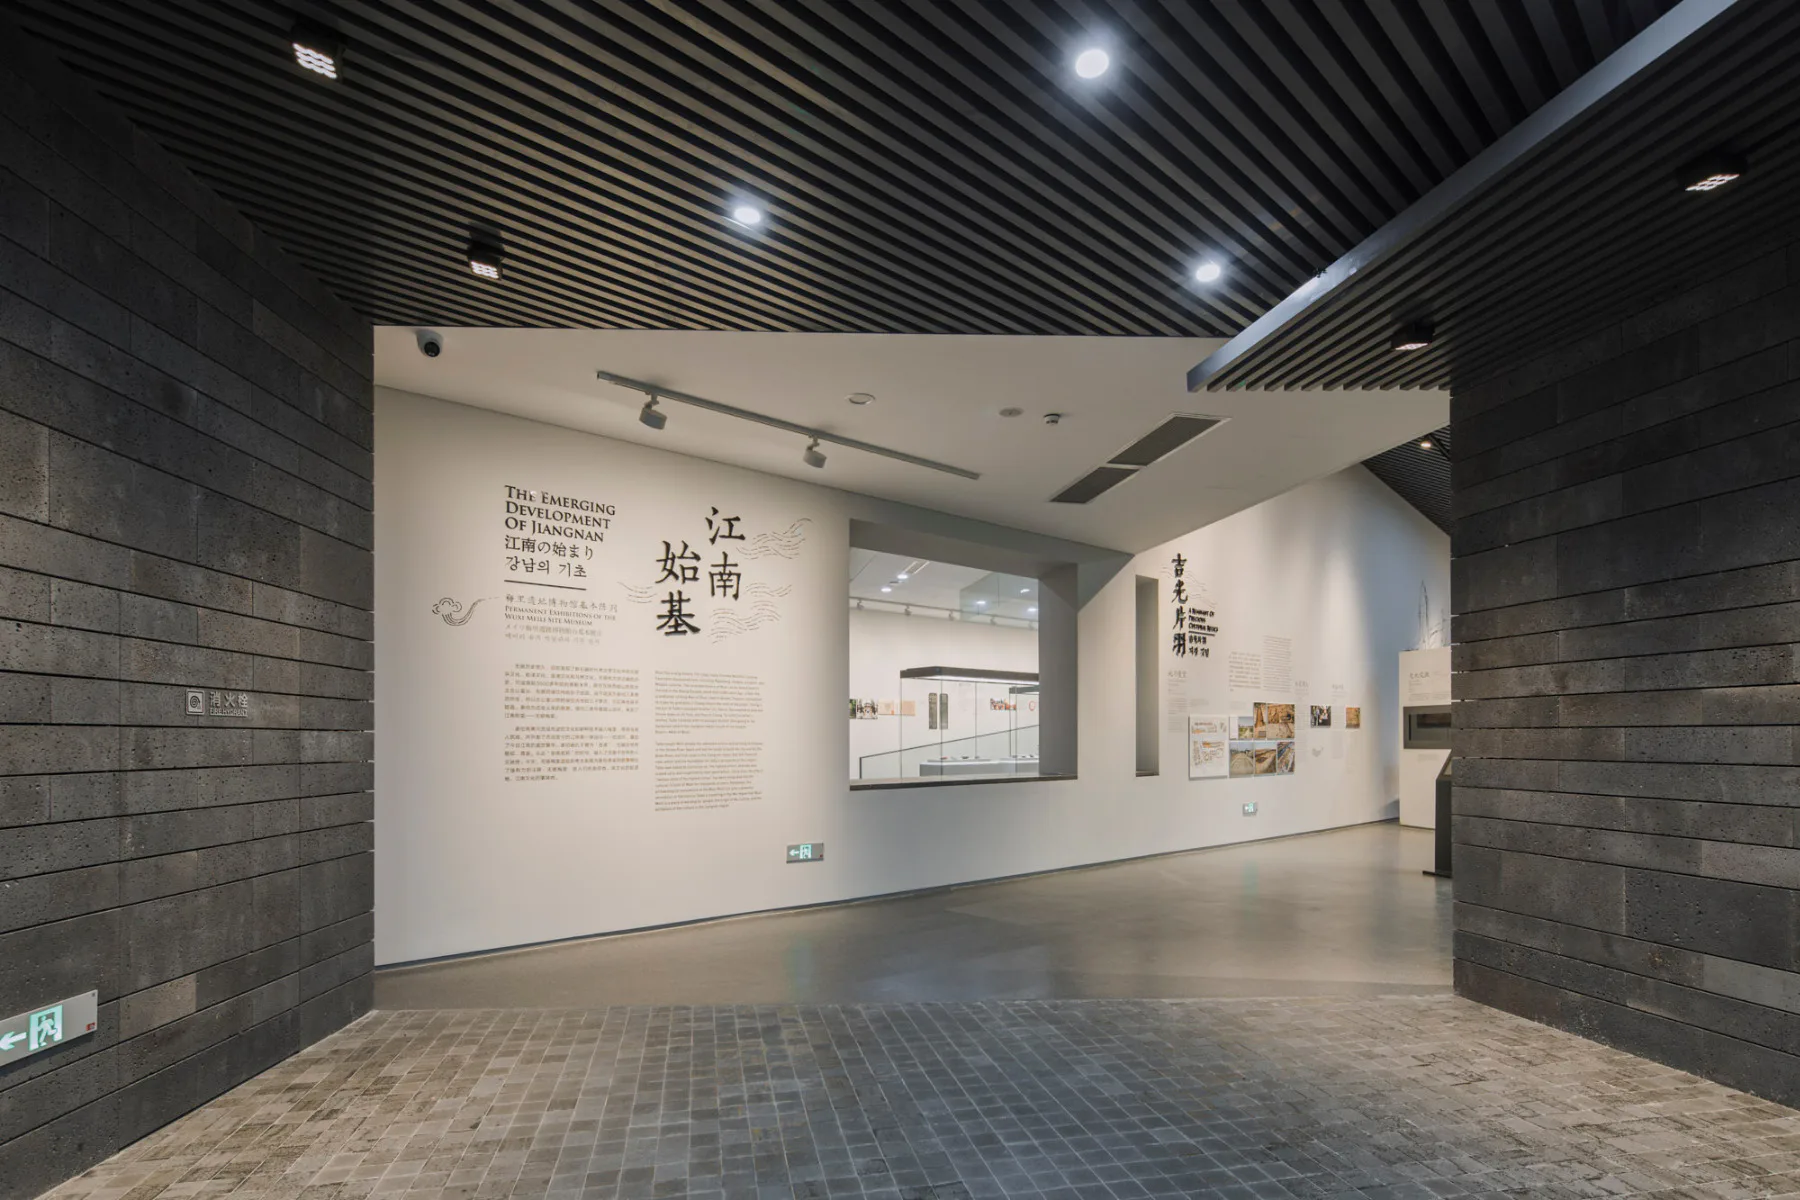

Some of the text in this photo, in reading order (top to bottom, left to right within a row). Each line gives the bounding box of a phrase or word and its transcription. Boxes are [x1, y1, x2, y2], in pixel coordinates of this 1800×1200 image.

[504, 485, 616, 516] THE EMERGING
[505, 500, 611, 529] DEVELOPMENT
[504, 516, 604, 542] OF JIANGNAN
[504, 534, 594, 561] 江南の始まり
[705, 506, 746, 601] 江南
[505, 555, 588, 578] 강남의 기초
[655, 540, 702, 637] 始基
[505, 604, 548, 615] PERMANENT
[1172, 553, 1188, 658] 吉光片羽
[563, 617, 593, 626] MUSEUM
[209, 691, 248, 708] 消火栓
